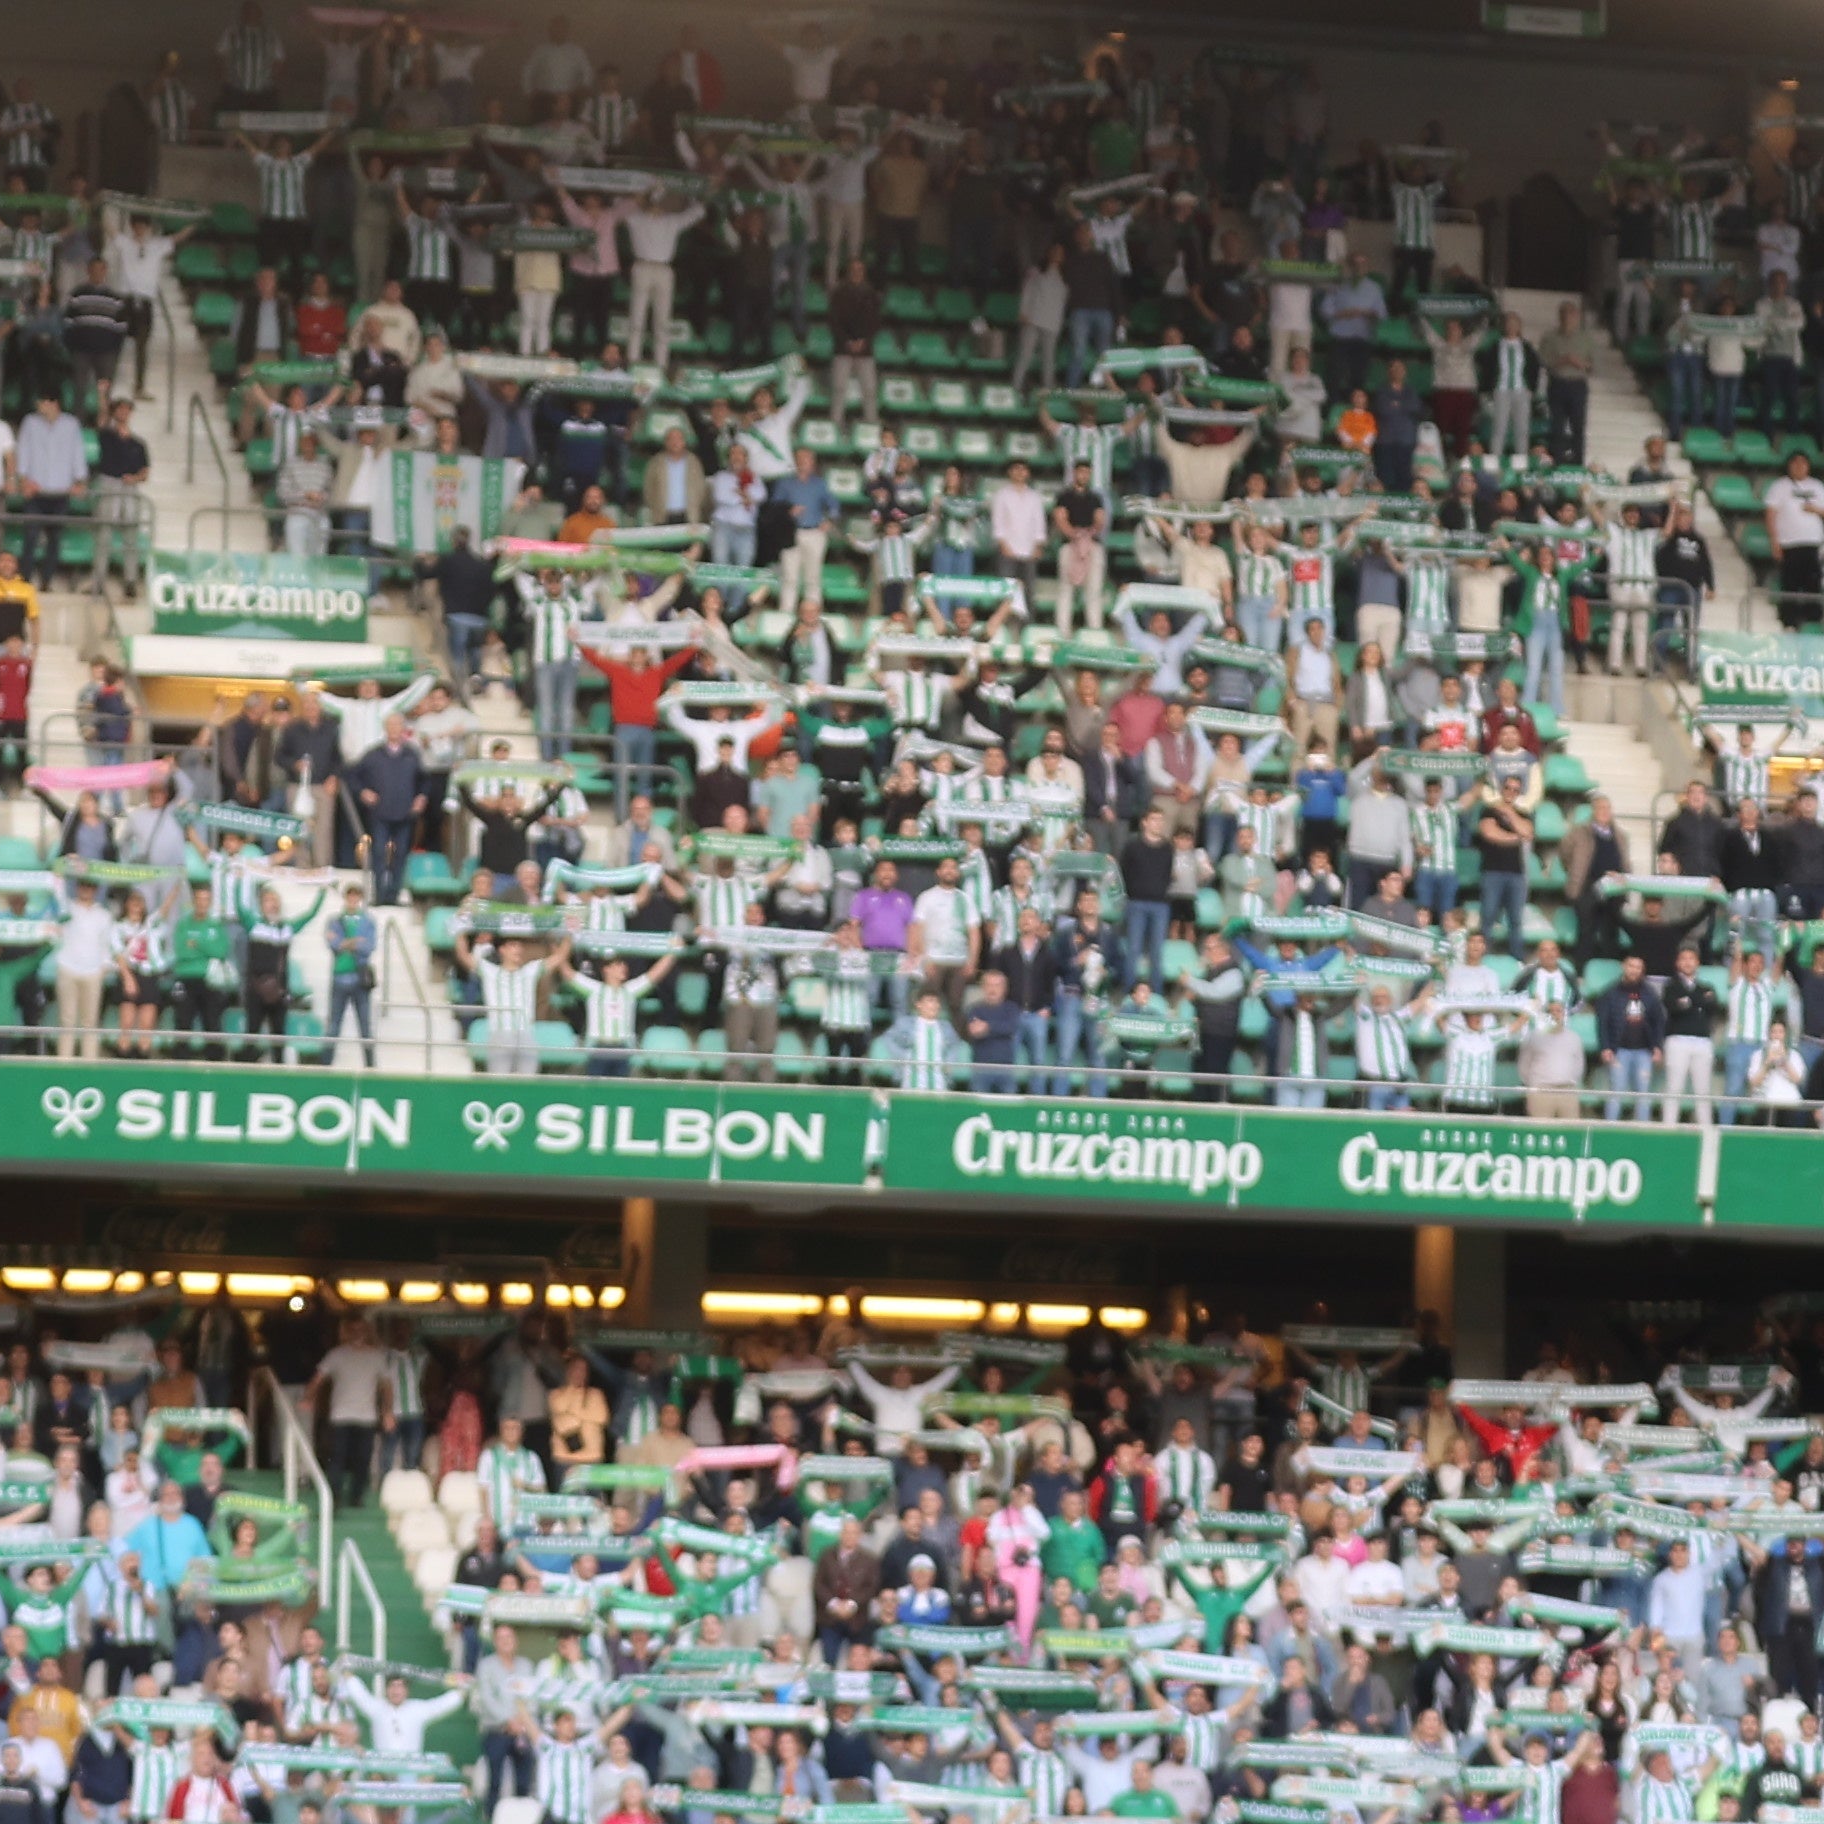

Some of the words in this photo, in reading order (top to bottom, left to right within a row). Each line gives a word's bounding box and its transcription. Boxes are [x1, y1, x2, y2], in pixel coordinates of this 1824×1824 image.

[151, 573, 363, 624] Cruzcampo
[115, 1088, 411, 1150] SILBON
[534, 1099, 826, 1161] SILBON
[952, 1113, 1263, 1194] Cruzcampo
[1339, 1132, 1642, 1205] Cruzcampo
